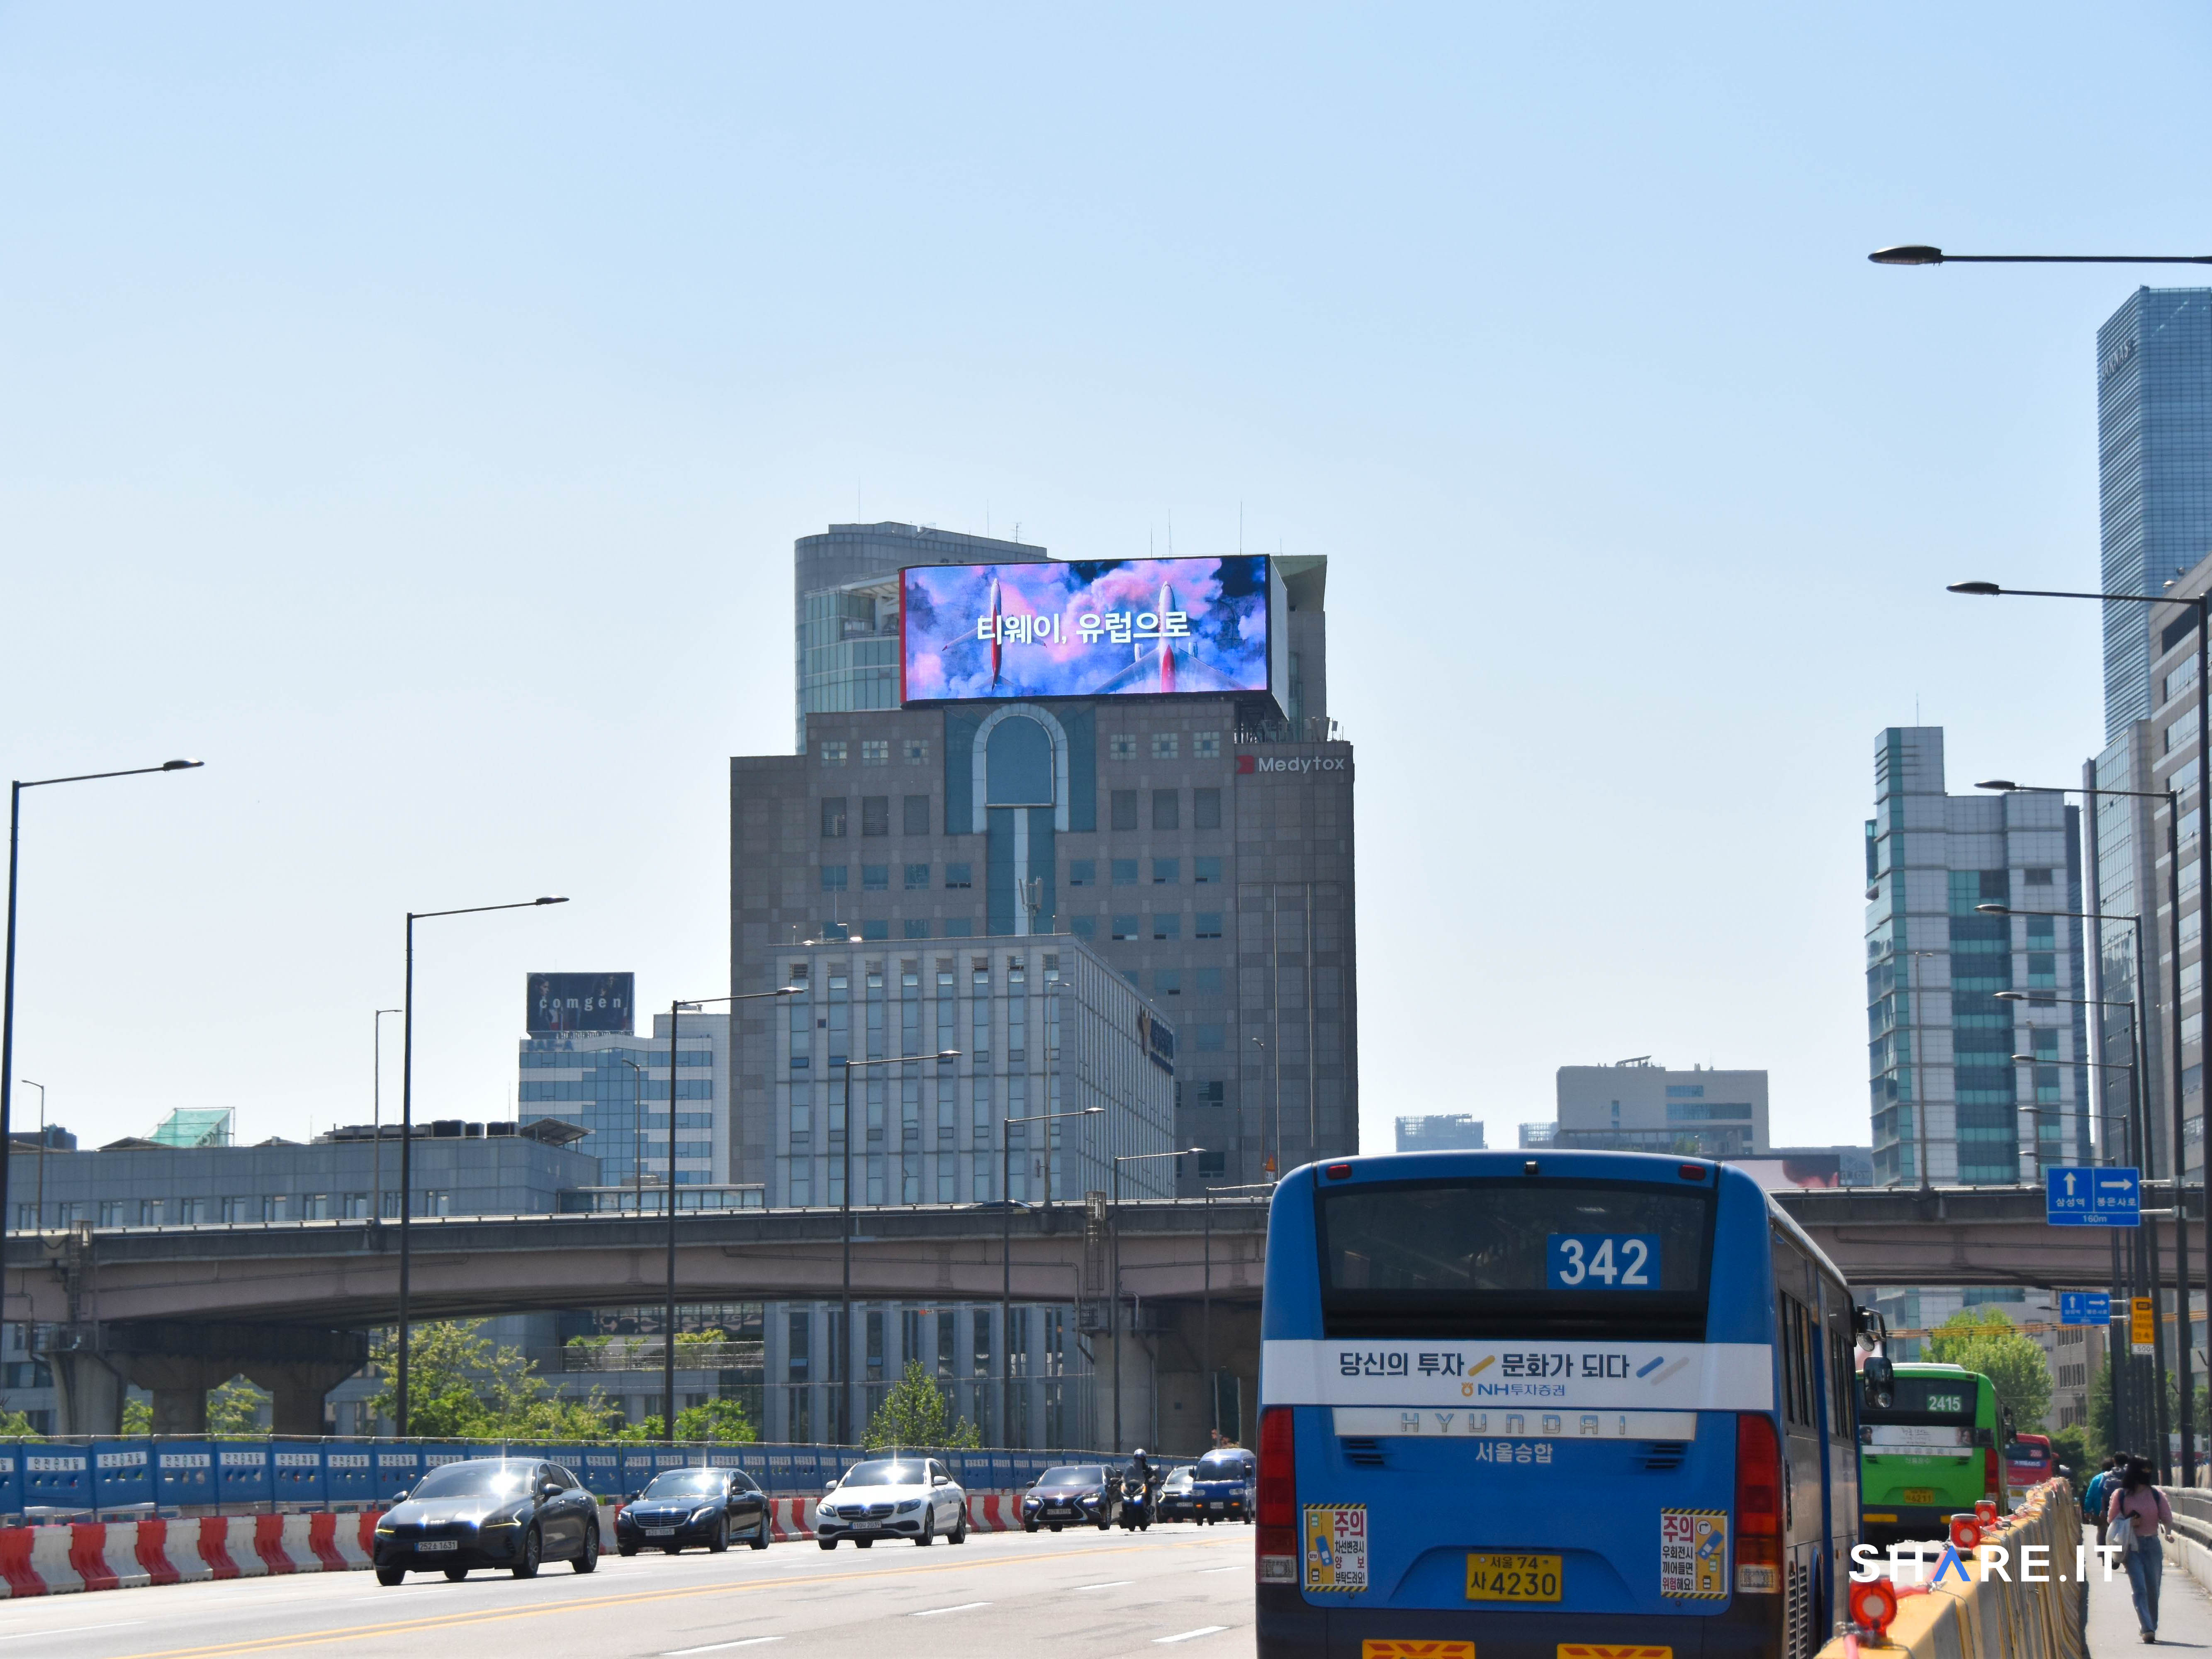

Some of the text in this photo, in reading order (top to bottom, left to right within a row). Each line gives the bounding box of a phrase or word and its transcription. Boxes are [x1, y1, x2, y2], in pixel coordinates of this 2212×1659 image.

[977, 611, 1190, 645] 티웨이, 유럽으로
[1258, 756, 1344, 774] Medytox
[540, 997, 621, 1011] comgen
[2056, 1198, 2085, 1207] 삼성역
[2097, 1197, 2137, 1207] 봉은사로
[1560, 1239, 1647, 1284] 342
[1340, 1352, 1630, 1378] 당신의 투자 문화가 되다
[1477, 1384, 1565, 1396] NH투자증권
[1929, 1396, 1961, 1411] 2415
[1402, 1413, 1625, 1435] HYUNDAI
[1475, 1442, 1553, 1464] 서울승합
[1334, 1511, 1364, 1537] 주의
[1663, 1516, 1694, 1543] 주의
[1335, 1540, 1364, 1554] 차선변경시
[1662, 1546, 1693, 1559] 우회전시
[1490, 1556, 1538, 1569] 서울 74
[1662, 1562, 1693, 1575] 끼어들면
[1335, 1571, 1365, 1584] 부탁드려요!
[1662, 1577, 1693, 1591] 위험해요!
